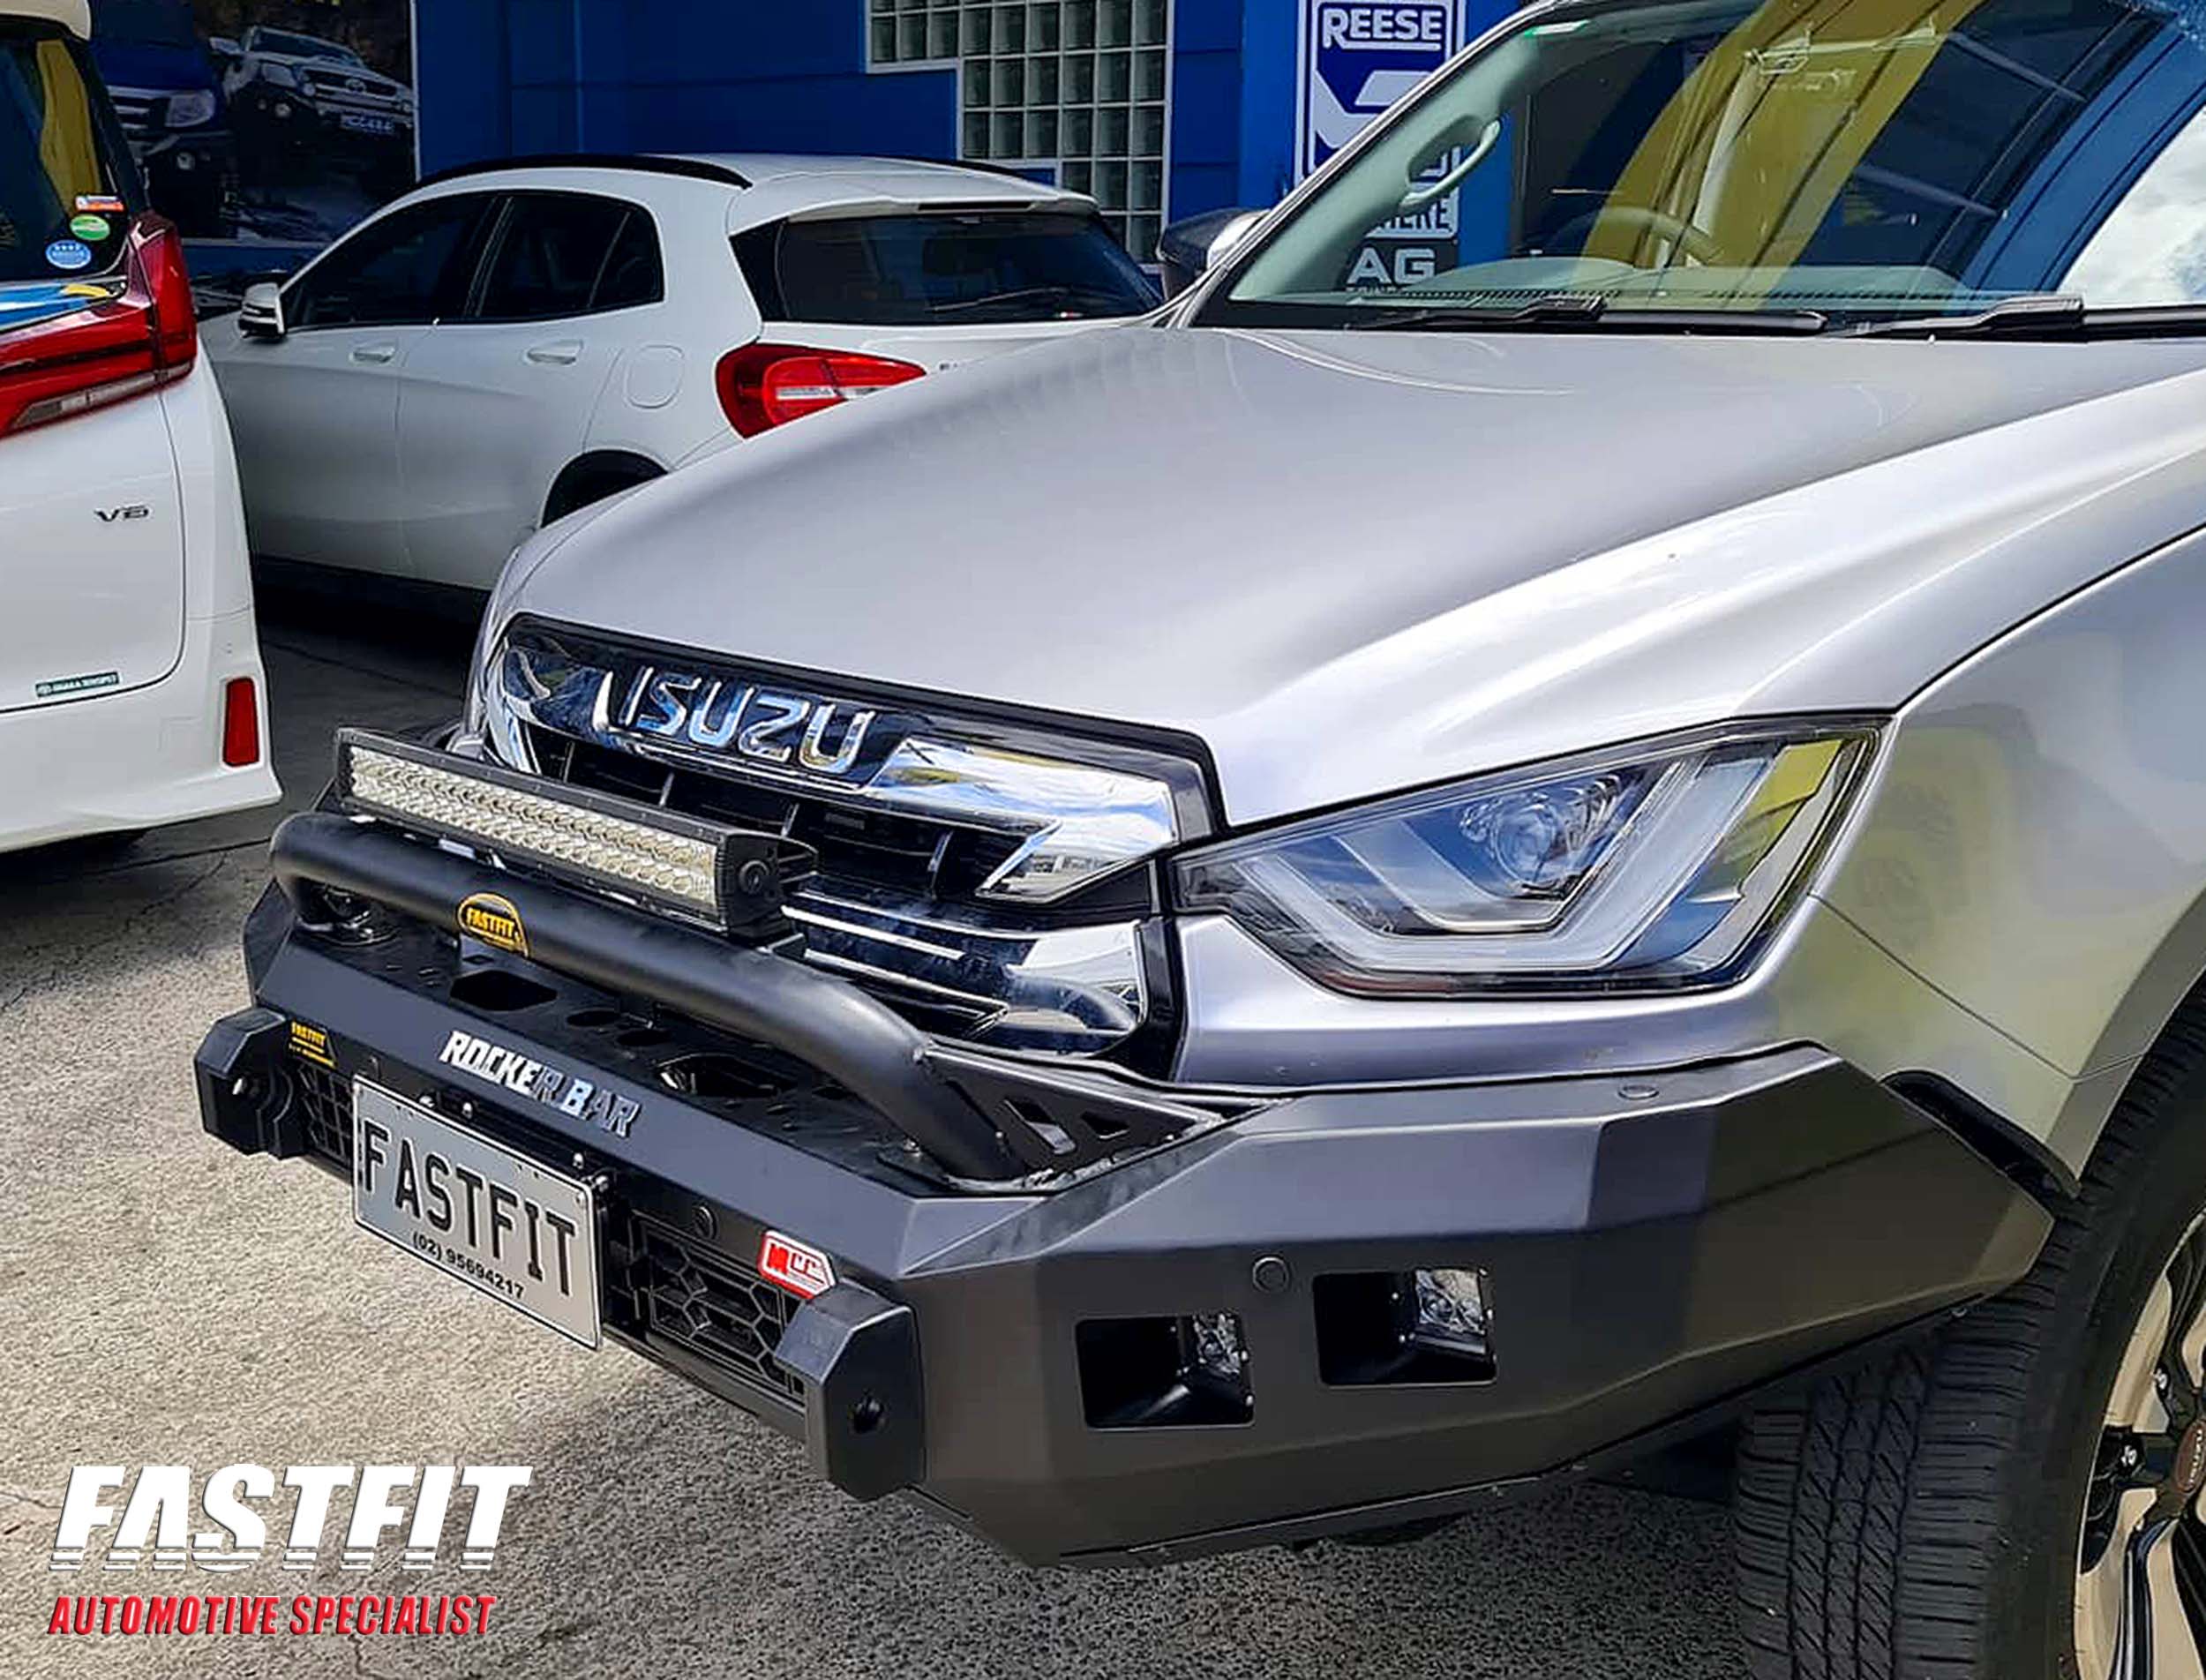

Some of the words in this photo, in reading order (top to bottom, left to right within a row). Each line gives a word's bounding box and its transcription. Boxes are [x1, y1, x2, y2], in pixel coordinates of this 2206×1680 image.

[1322, 8, 1443, 50] REESE
[619, 666, 875, 775] ISUZU
[439, 1030, 565, 1105] ROCKER
[559, 1078, 642, 1137] BAR
[362, 1117, 576, 1297] FASTFIT
[412, 1231, 442, 1262] (02)
[446, 1248, 524, 1299] 95694217
